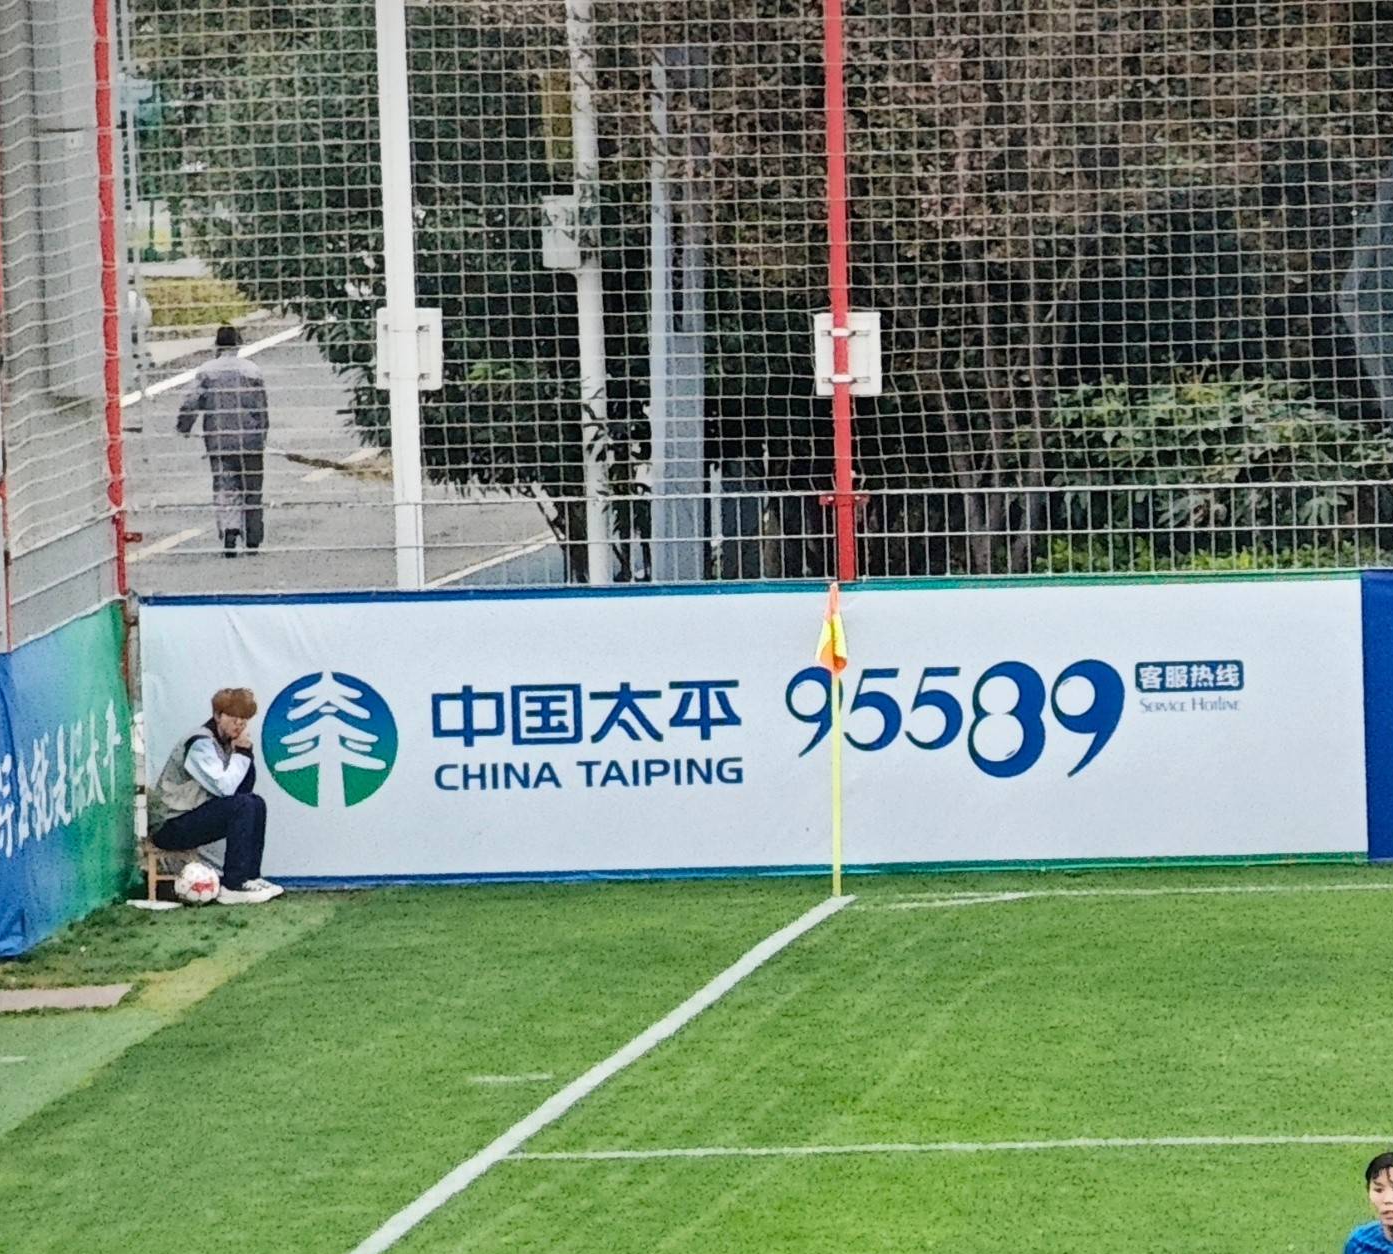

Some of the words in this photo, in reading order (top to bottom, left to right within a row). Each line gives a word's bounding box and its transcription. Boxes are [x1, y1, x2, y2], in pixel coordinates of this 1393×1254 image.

[1139, 664, 1240, 690] 客服热线
[431, 679, 743, 747] 中国太平
[784, 658, 1126, 779] 95589
[434, 761, 558, 792] CHINA
[576, 756, 744, 787] TAIPING
